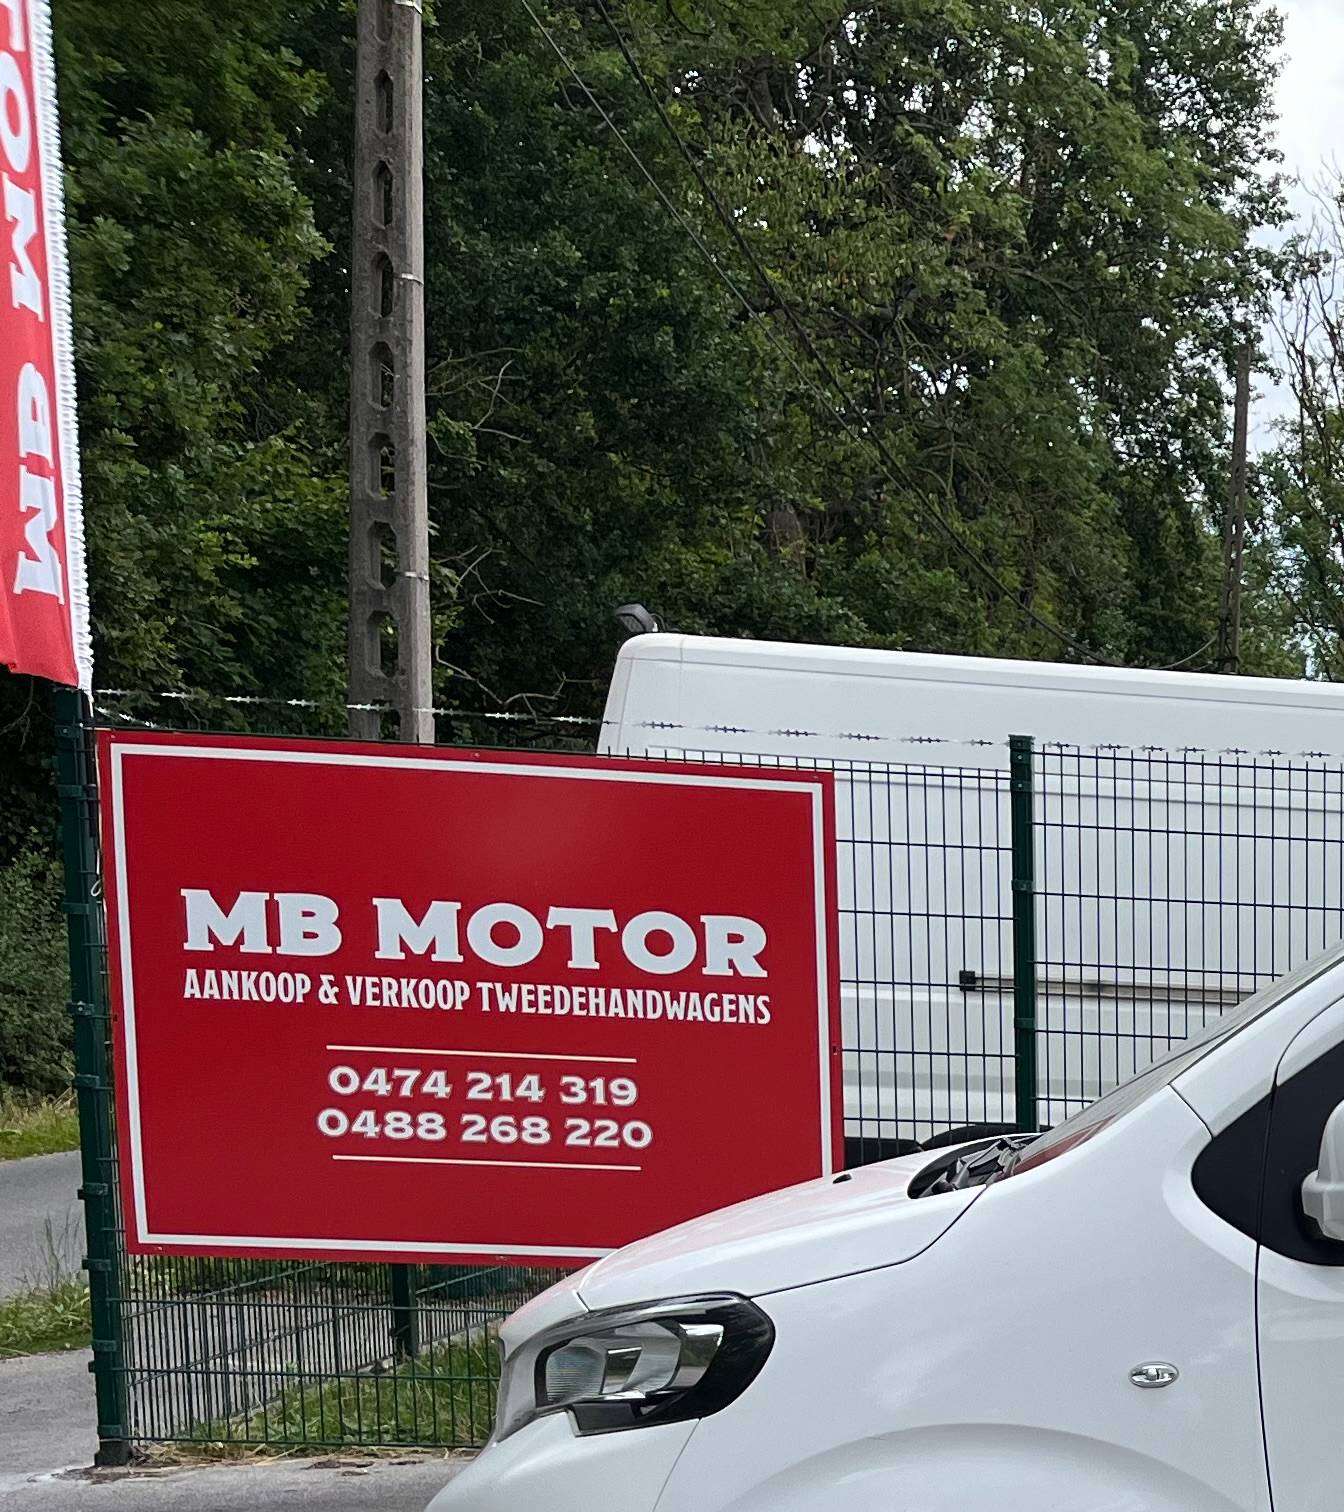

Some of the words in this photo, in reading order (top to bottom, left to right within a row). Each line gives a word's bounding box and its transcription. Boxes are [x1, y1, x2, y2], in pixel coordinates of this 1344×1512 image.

[180, 888, 343, 957] MB
[372, 897, 769, 978] MOTOR
[183, 968, 312, 1003] AANKOOP
[318, 974, 340, 1005] &
[345, 975, 471, 1010] VERKOOP
[476, 981, 771, 1025] TWEEDEHANDWAGENS
[327, 1065, 452, 1099] 0474
[467, 1071, 545, 1103] 214
[560, 1075, 638, 1107] 319
[317, 1108, 447, 1141] 0488
[460, 1114, 551, 1146] 268
[564, 1118, 653, 1149] 220
